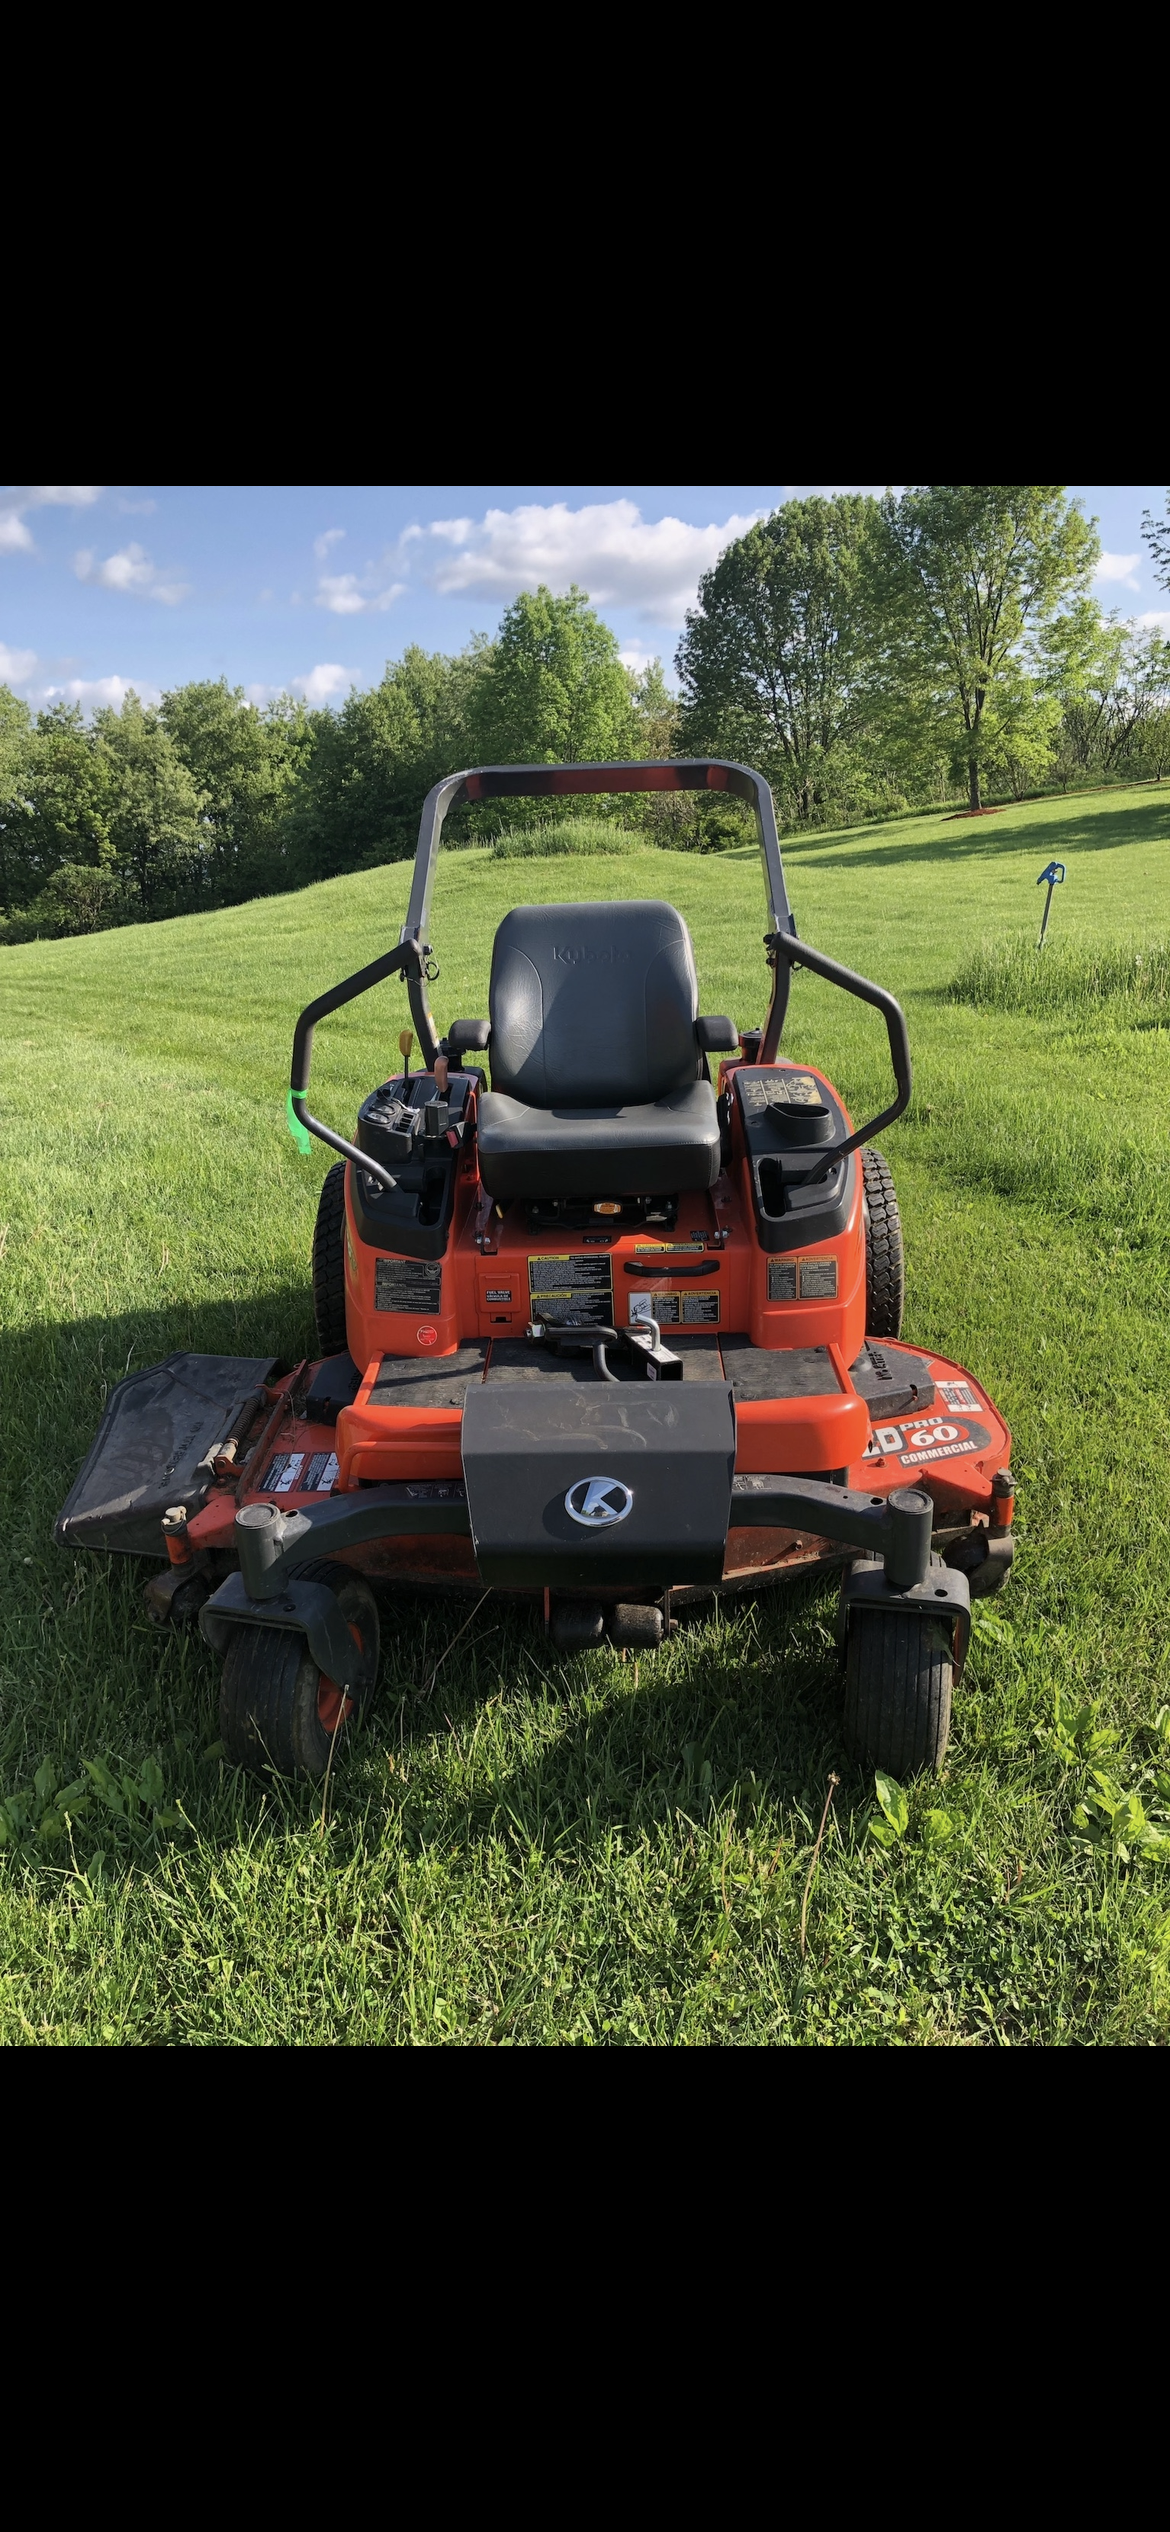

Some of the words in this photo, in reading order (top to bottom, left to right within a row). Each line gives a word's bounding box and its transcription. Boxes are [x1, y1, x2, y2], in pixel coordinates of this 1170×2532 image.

[552, 945, 631, 965] Kubota
[899, 1416, 944, 1432] PRO
[910, 1425, 958, 1447] 60
[900, 1440, 978, 1465] COMMERCIAL
